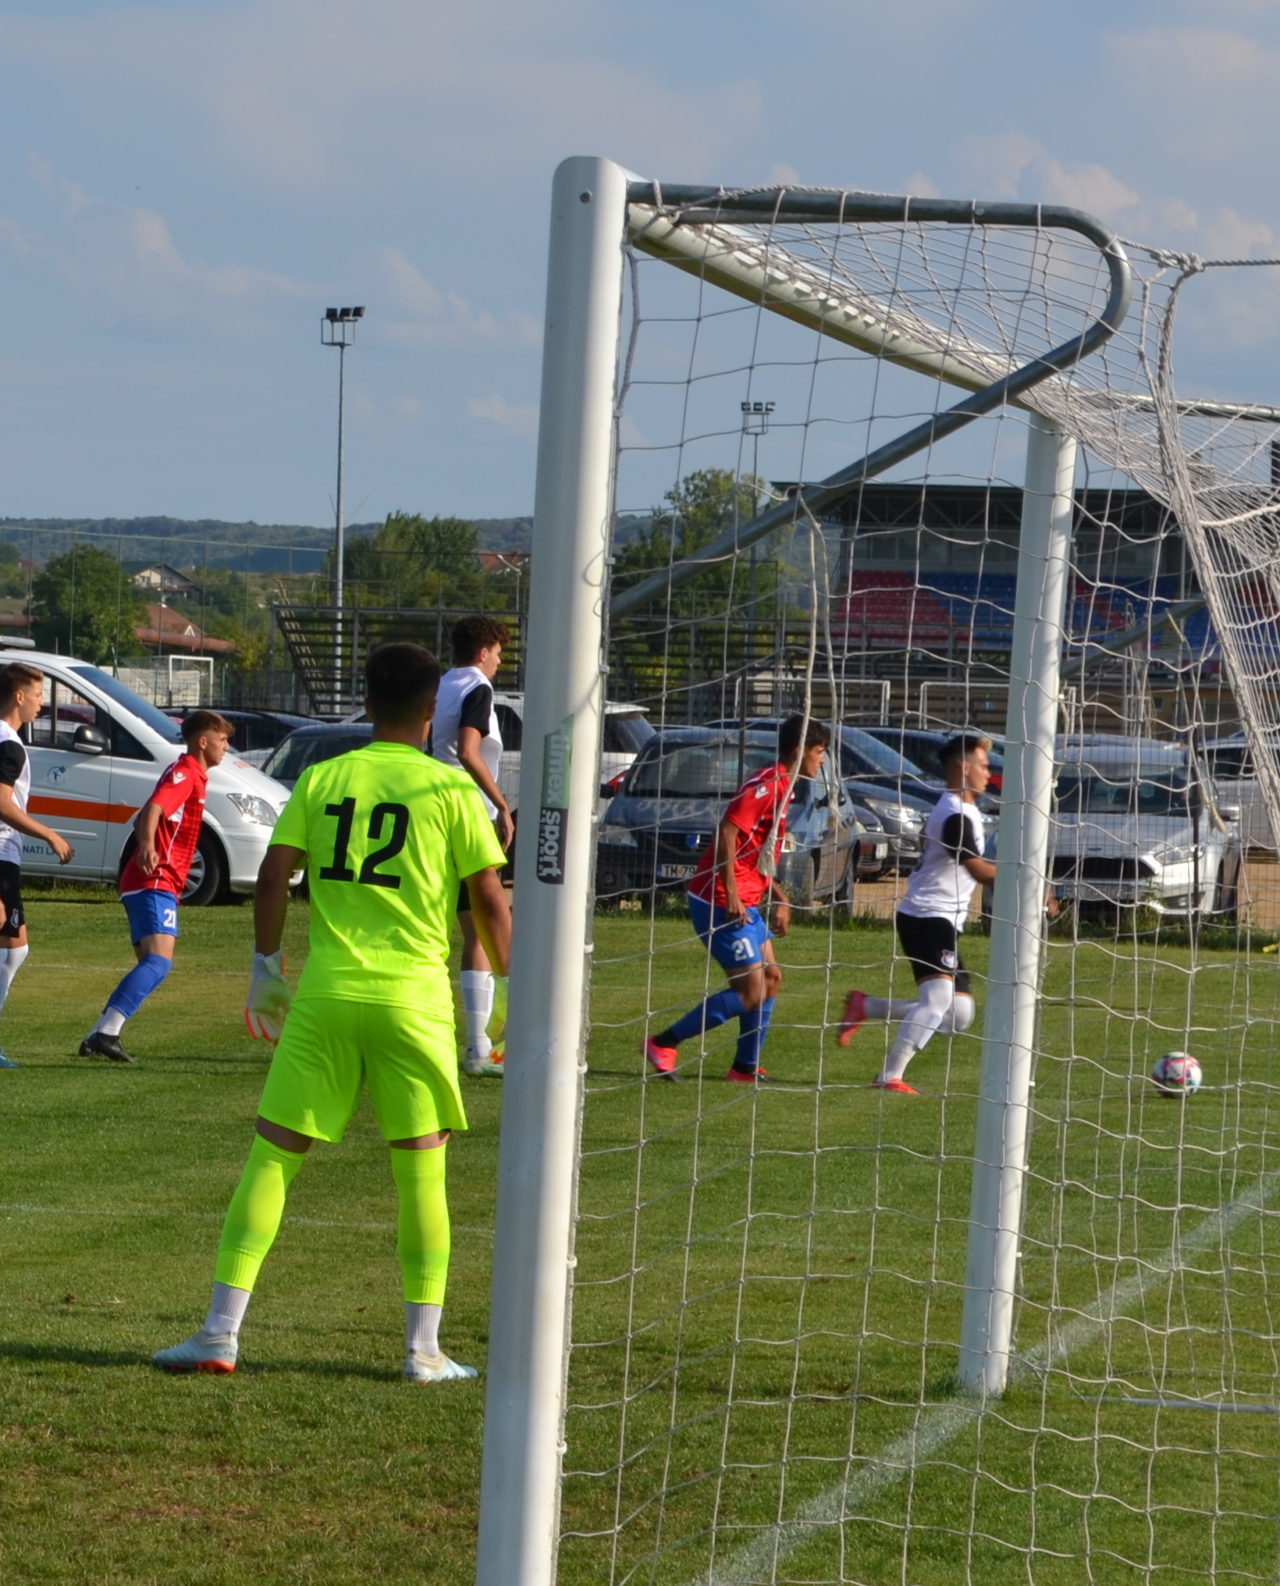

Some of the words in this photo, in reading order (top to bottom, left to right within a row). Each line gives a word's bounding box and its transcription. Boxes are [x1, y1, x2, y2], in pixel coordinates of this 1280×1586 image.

[319, 797, 410, 889] 12
[542, 810, 562, 878] sport
[163, 908, 177, 929] 21
[732, 937, 755, 961] 21
